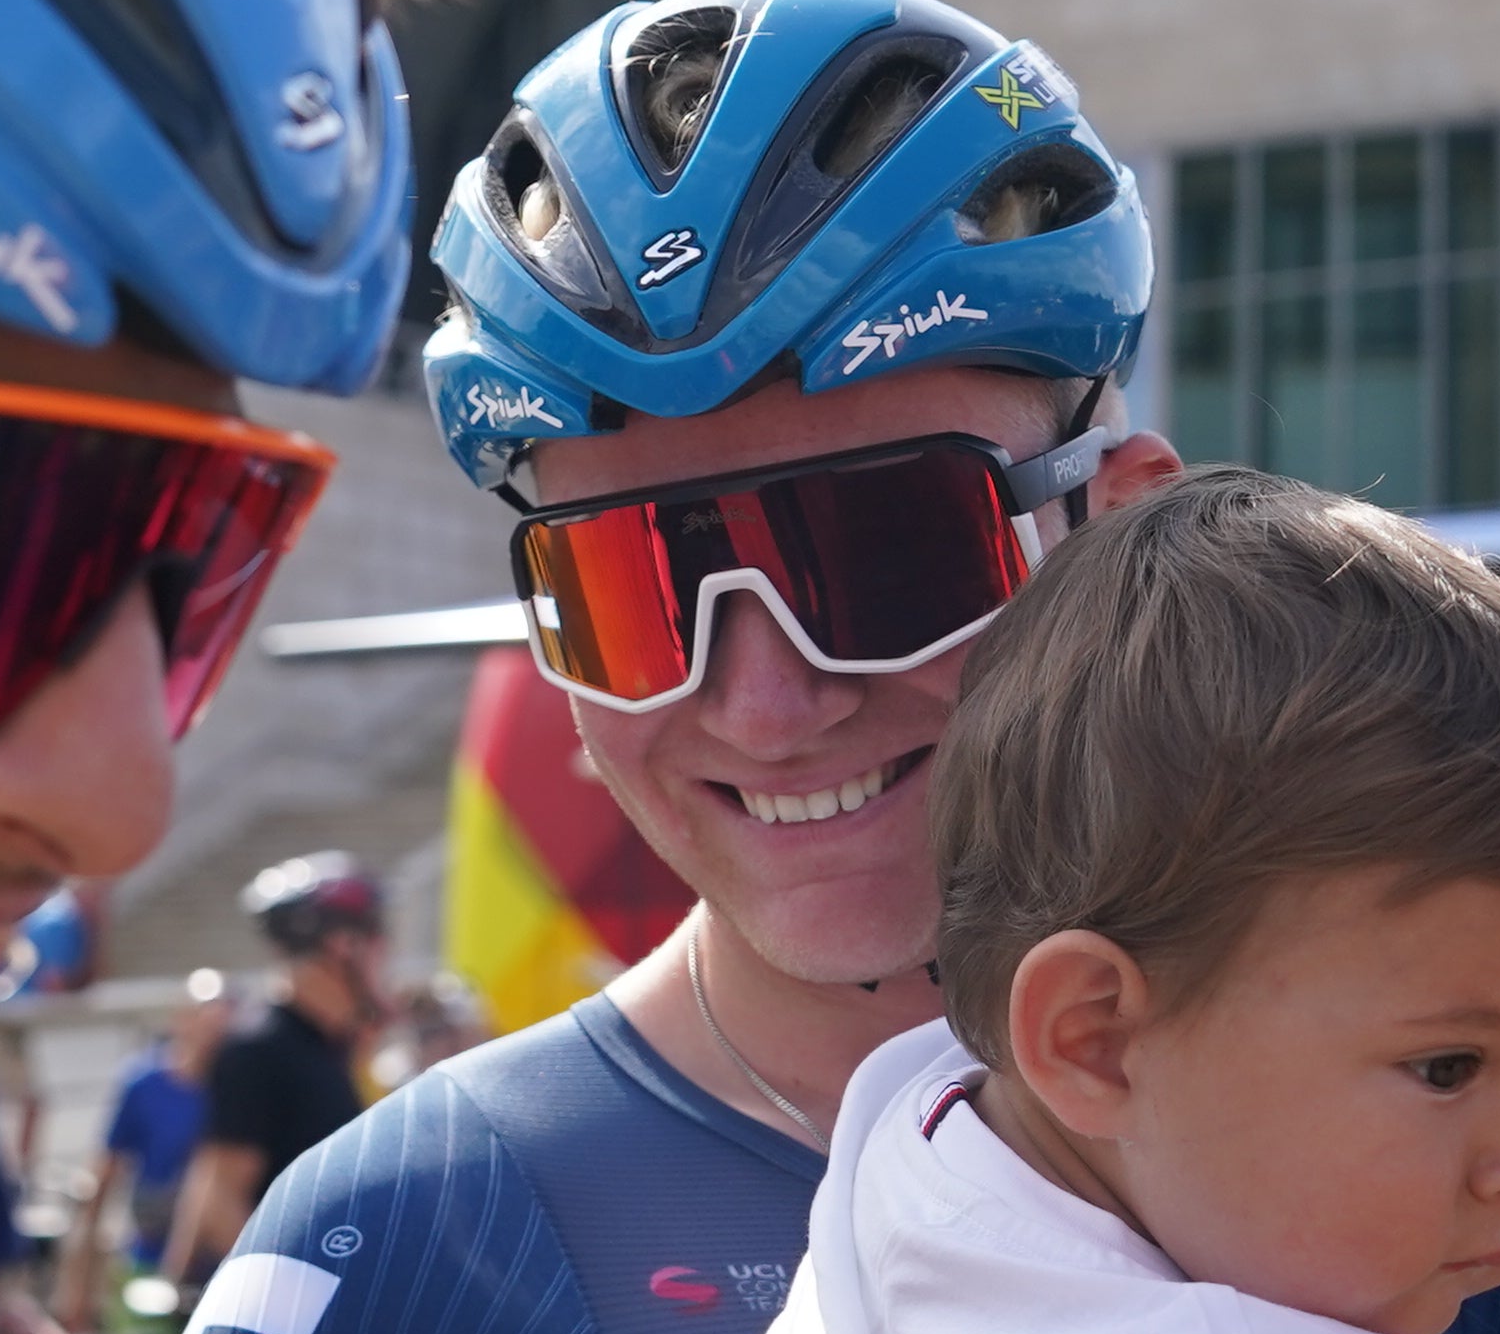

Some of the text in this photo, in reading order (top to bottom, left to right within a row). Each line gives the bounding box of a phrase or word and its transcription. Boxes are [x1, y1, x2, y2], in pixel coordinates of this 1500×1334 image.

[842, 289, 988, 376] Spiuk
[467, 383, 564, 429] Spiuk
[727, 1263, 786, 1280] UCI
